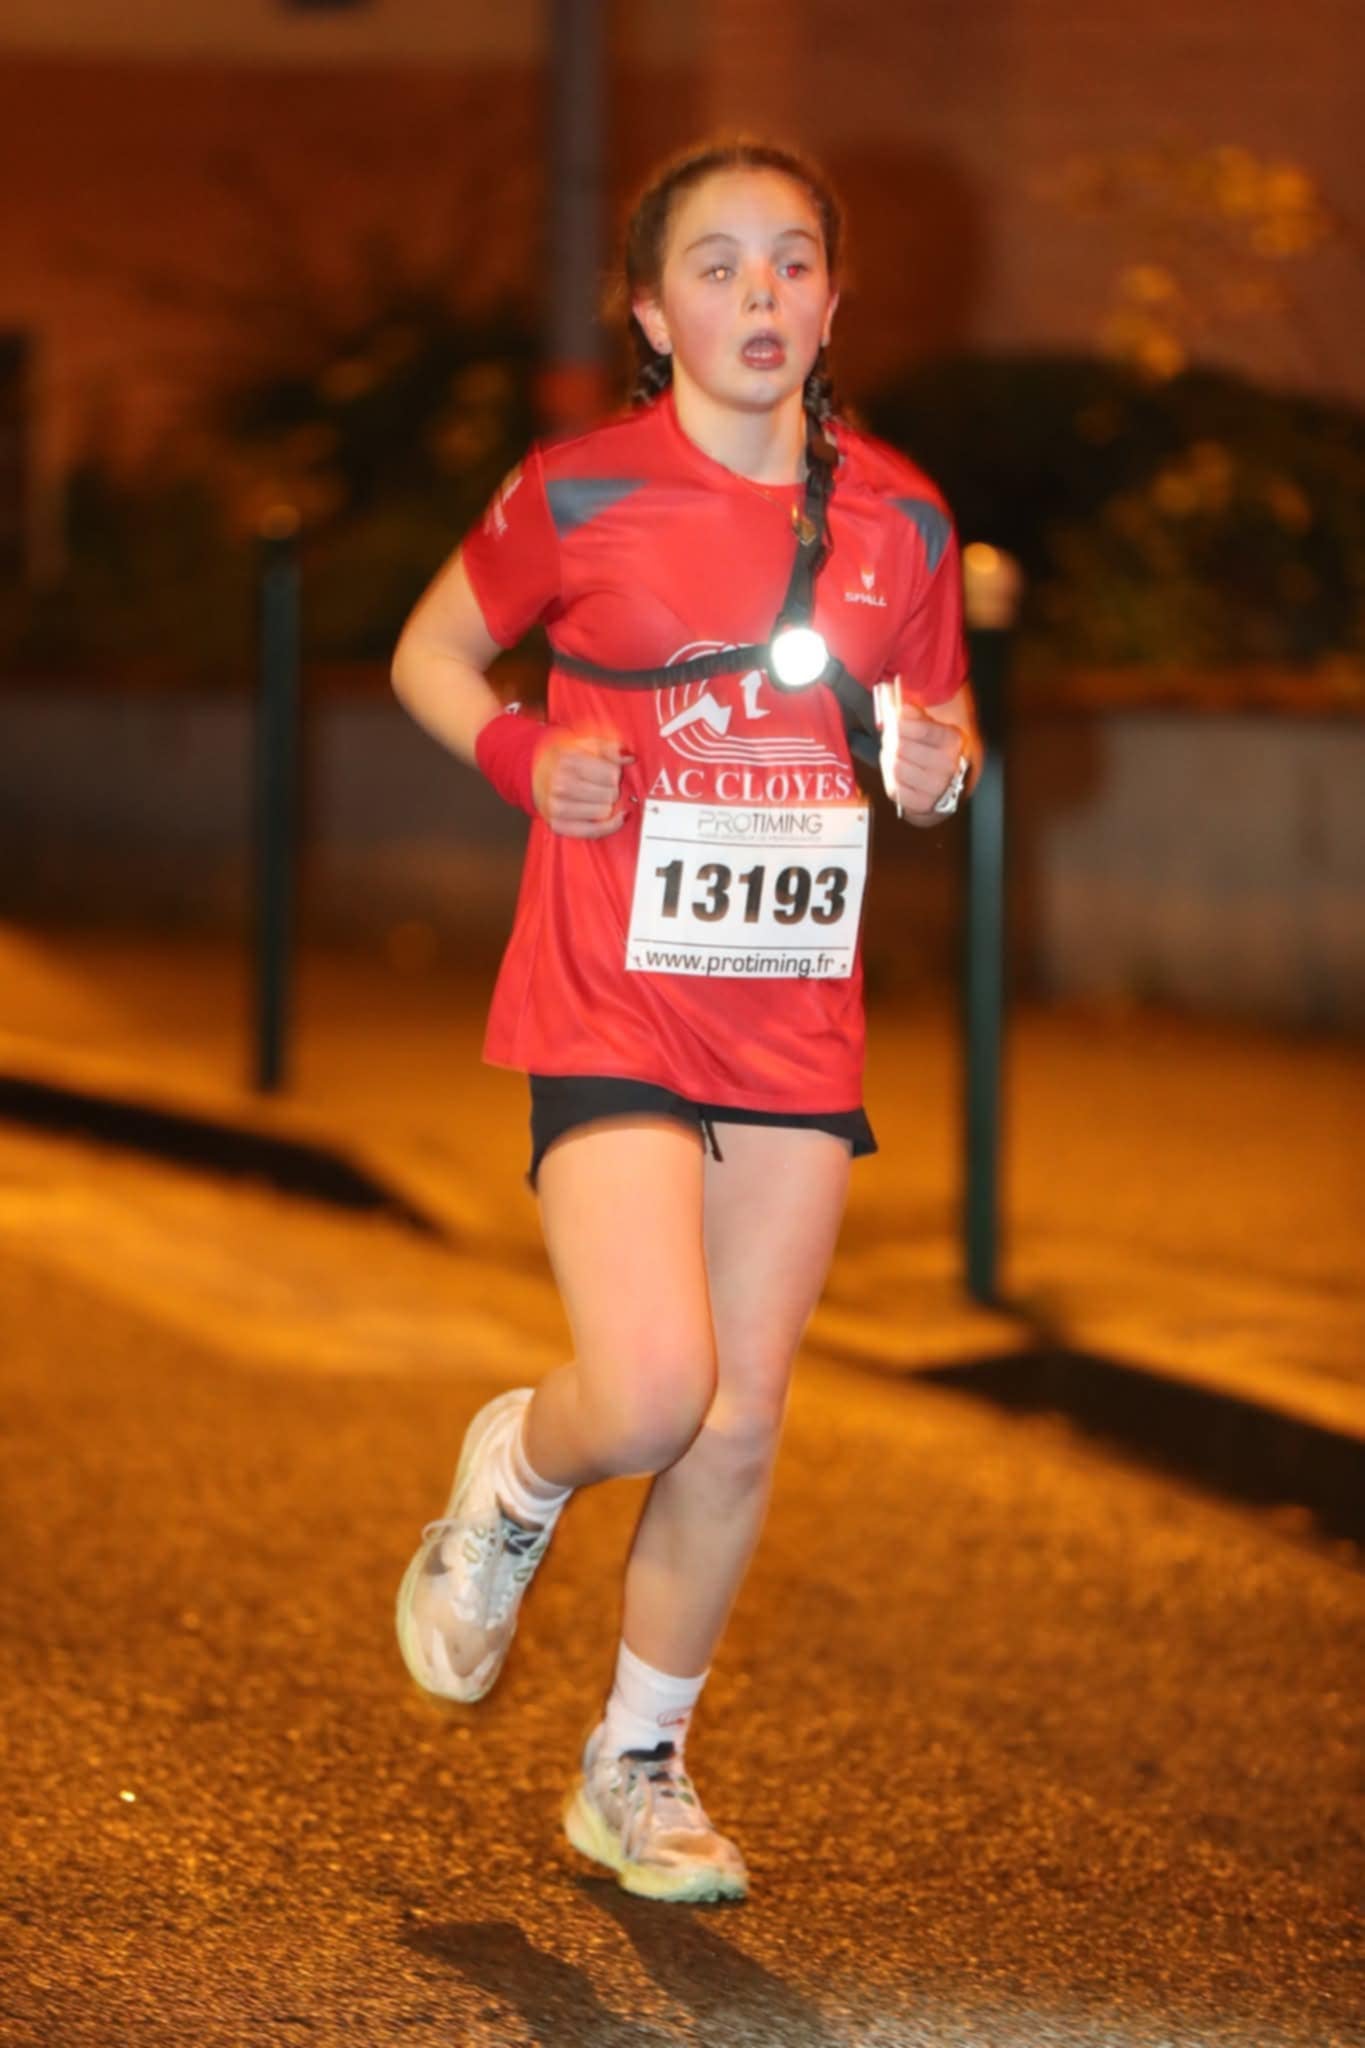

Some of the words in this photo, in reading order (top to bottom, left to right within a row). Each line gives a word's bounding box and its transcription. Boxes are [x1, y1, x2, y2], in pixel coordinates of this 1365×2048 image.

[650, 767, 704, 798] AC
[715, 770, 853, 801] CLOYES
[696, 810, 823, 835] PROTIMING
[655, 859, 849, 926] 13193
[645, 950, 835, 977] www.protiming.fr
